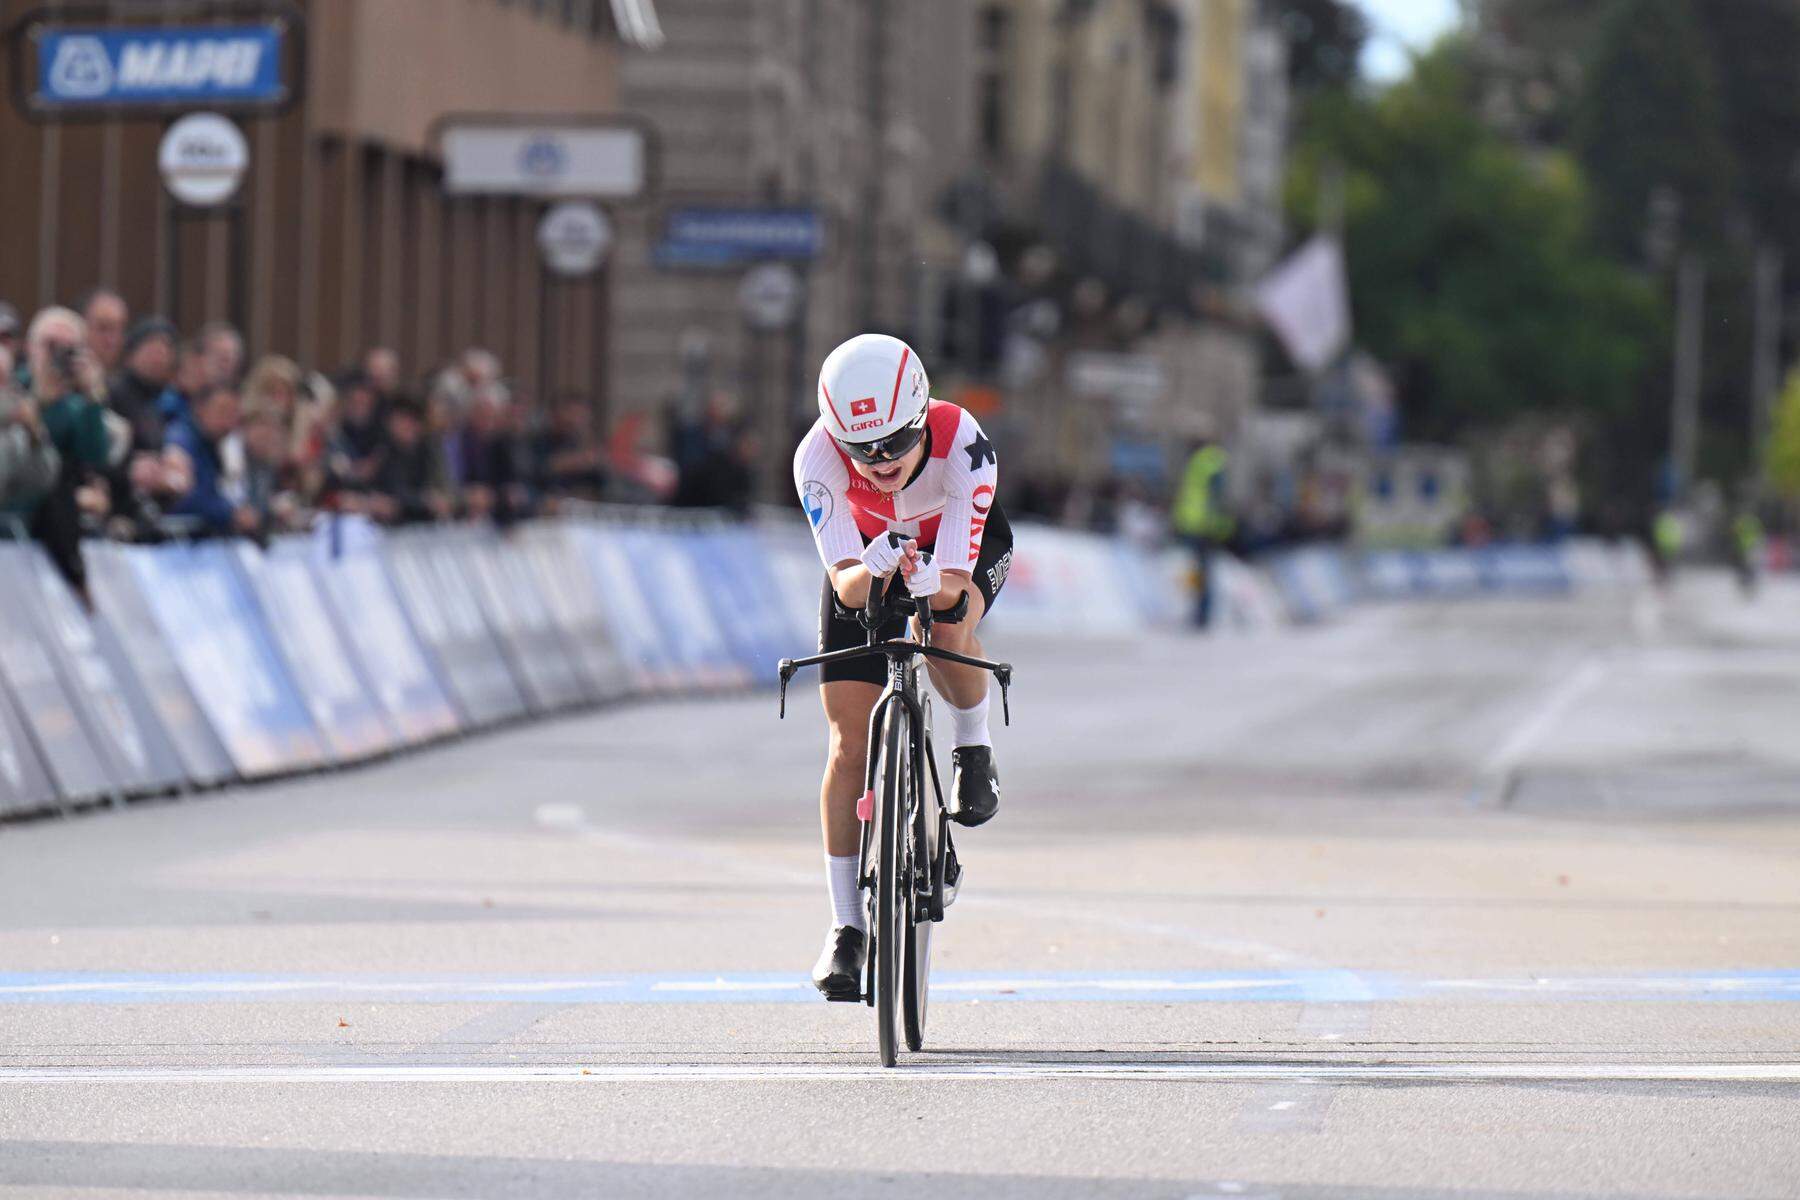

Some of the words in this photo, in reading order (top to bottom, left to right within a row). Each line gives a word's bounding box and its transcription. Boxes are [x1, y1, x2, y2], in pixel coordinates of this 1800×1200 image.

[117, 40, 262, 90] MAPEI
[851, 418, 884, 432] GIRO
[893, 661, 904, 692] BMC
